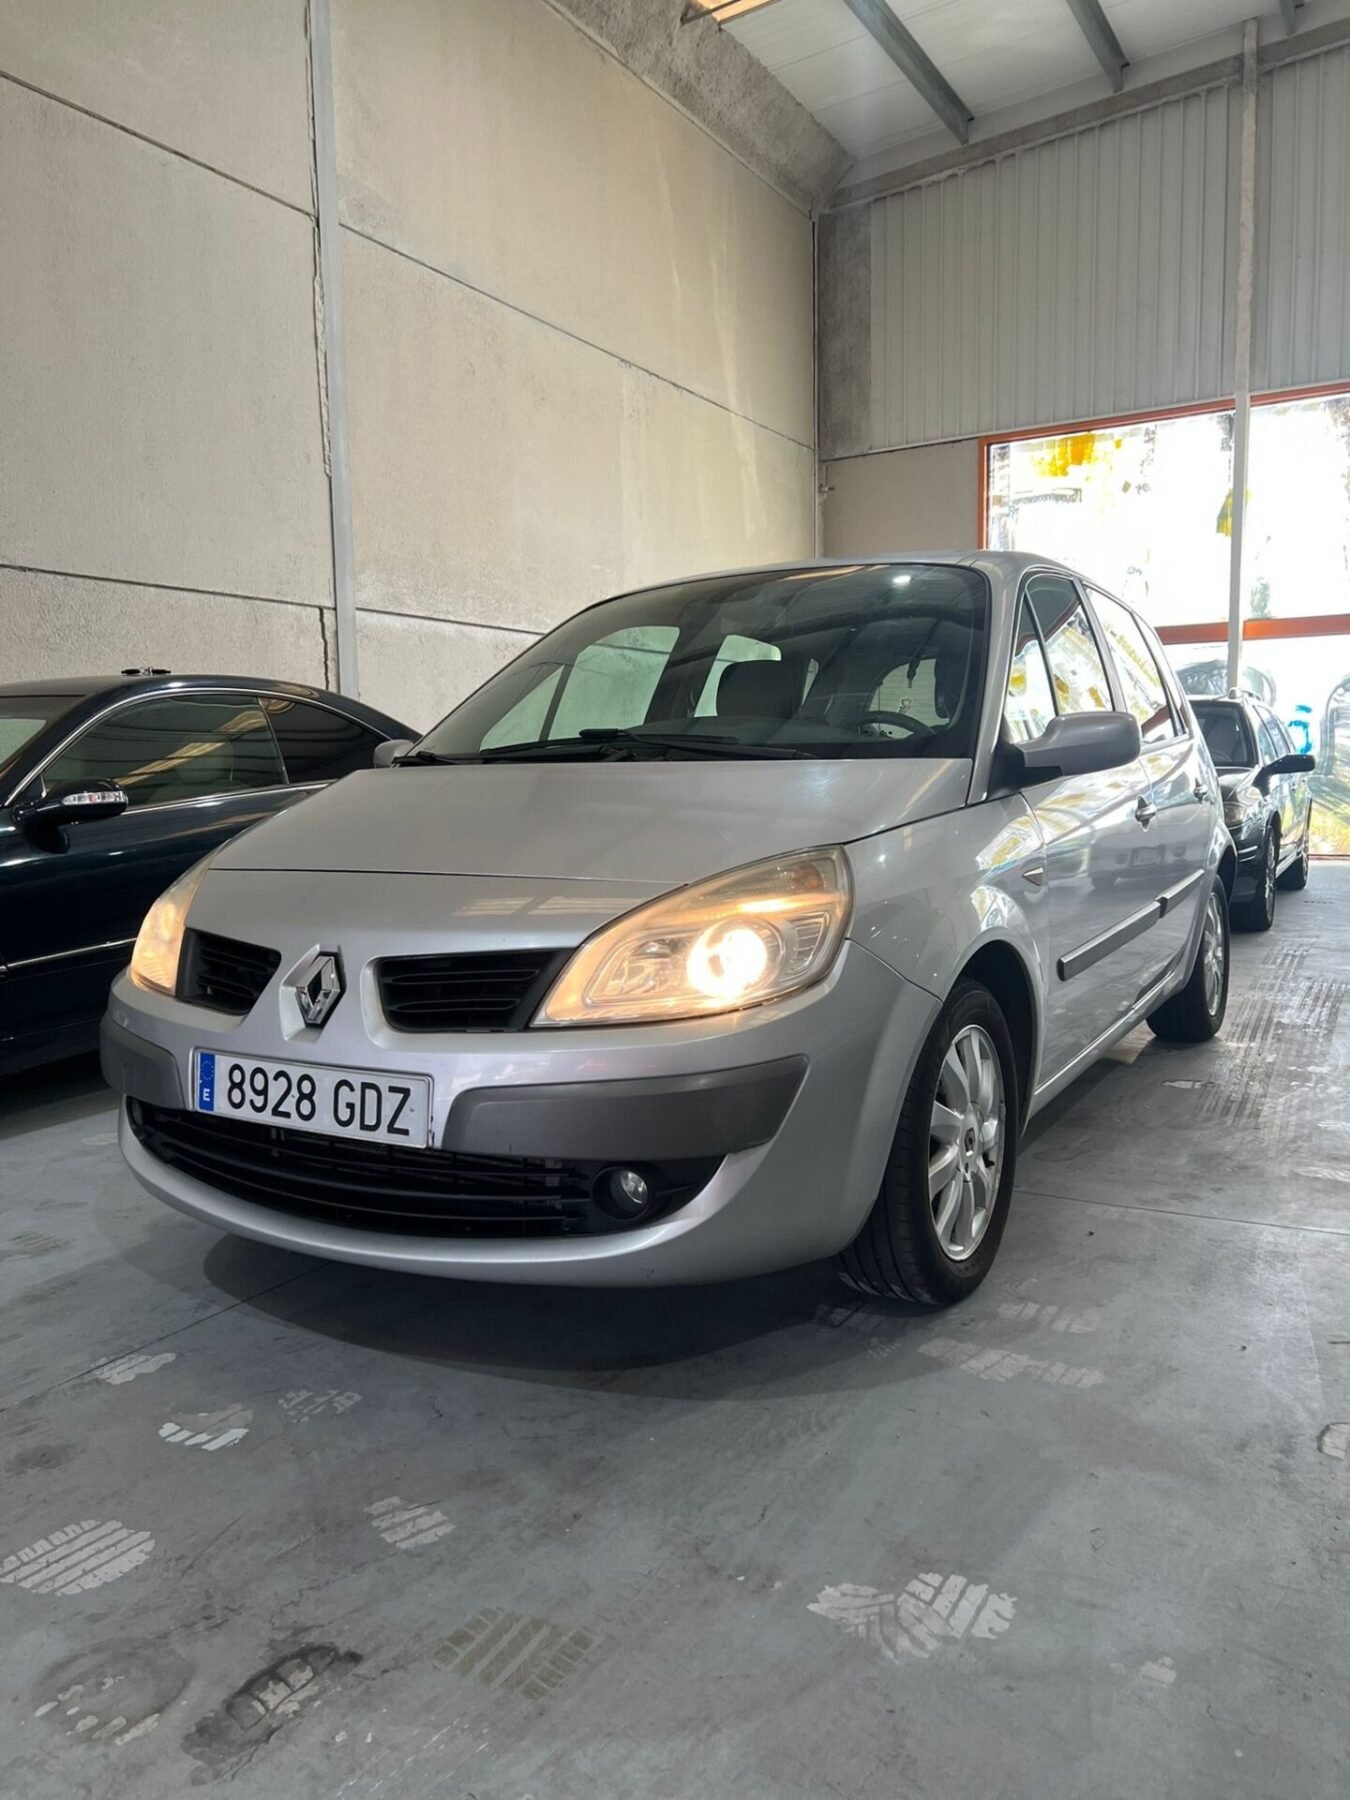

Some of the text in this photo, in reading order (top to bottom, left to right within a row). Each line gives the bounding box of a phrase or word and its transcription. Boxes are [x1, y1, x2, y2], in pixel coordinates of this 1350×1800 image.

[203, 1088, 211, 1102] E
[227, 1063, 411, 1136] 8928 GDZ
